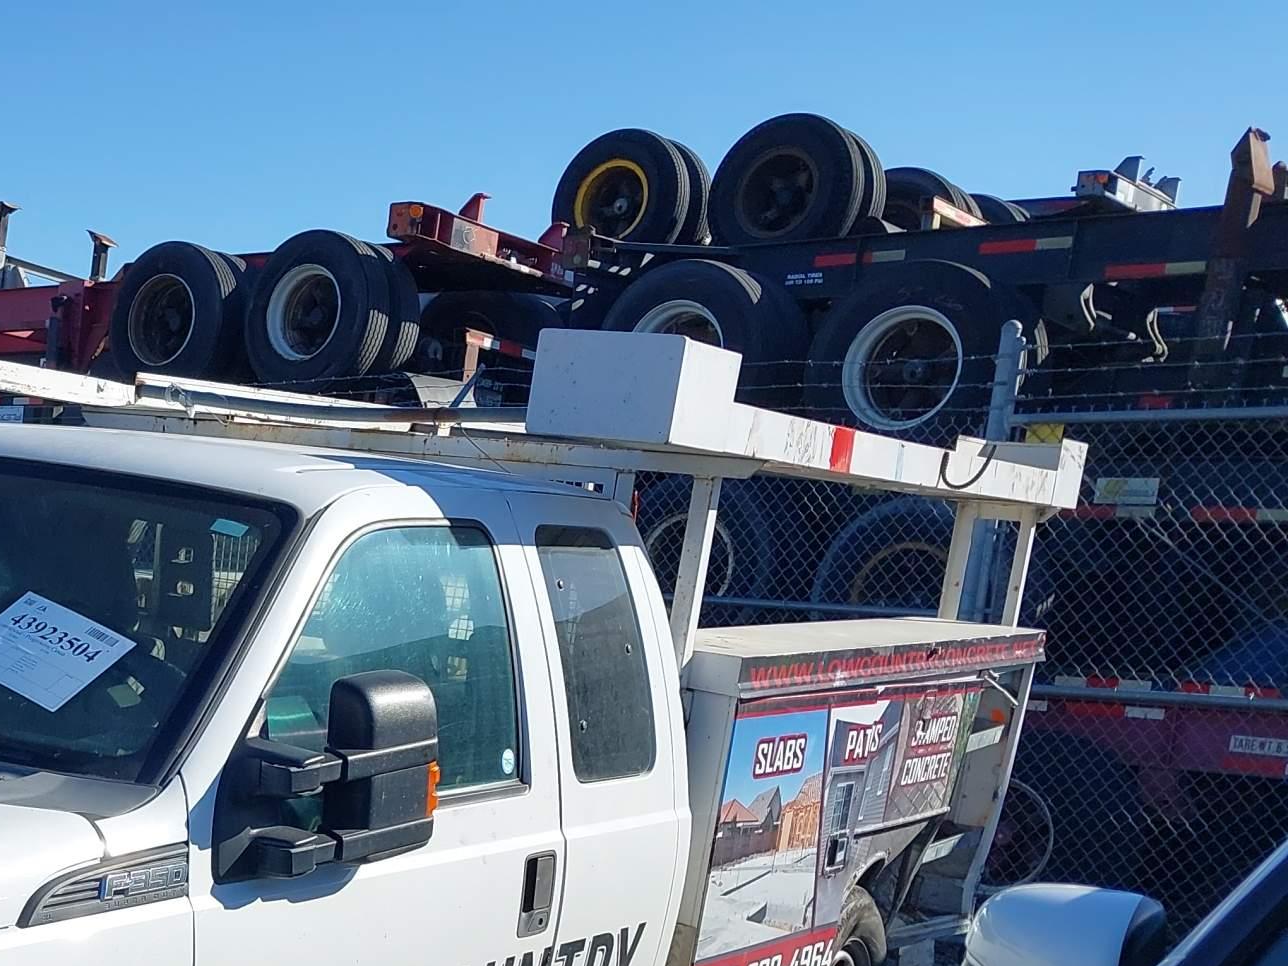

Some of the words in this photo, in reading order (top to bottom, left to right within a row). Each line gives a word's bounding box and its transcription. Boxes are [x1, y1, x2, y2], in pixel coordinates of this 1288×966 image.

[10, 613, 104, 664] 43923504
[754, 737, 806, 775] SLABS
[900, 752, 951, 786] CONCRETE
[103, 862, 188, 900] F-350
